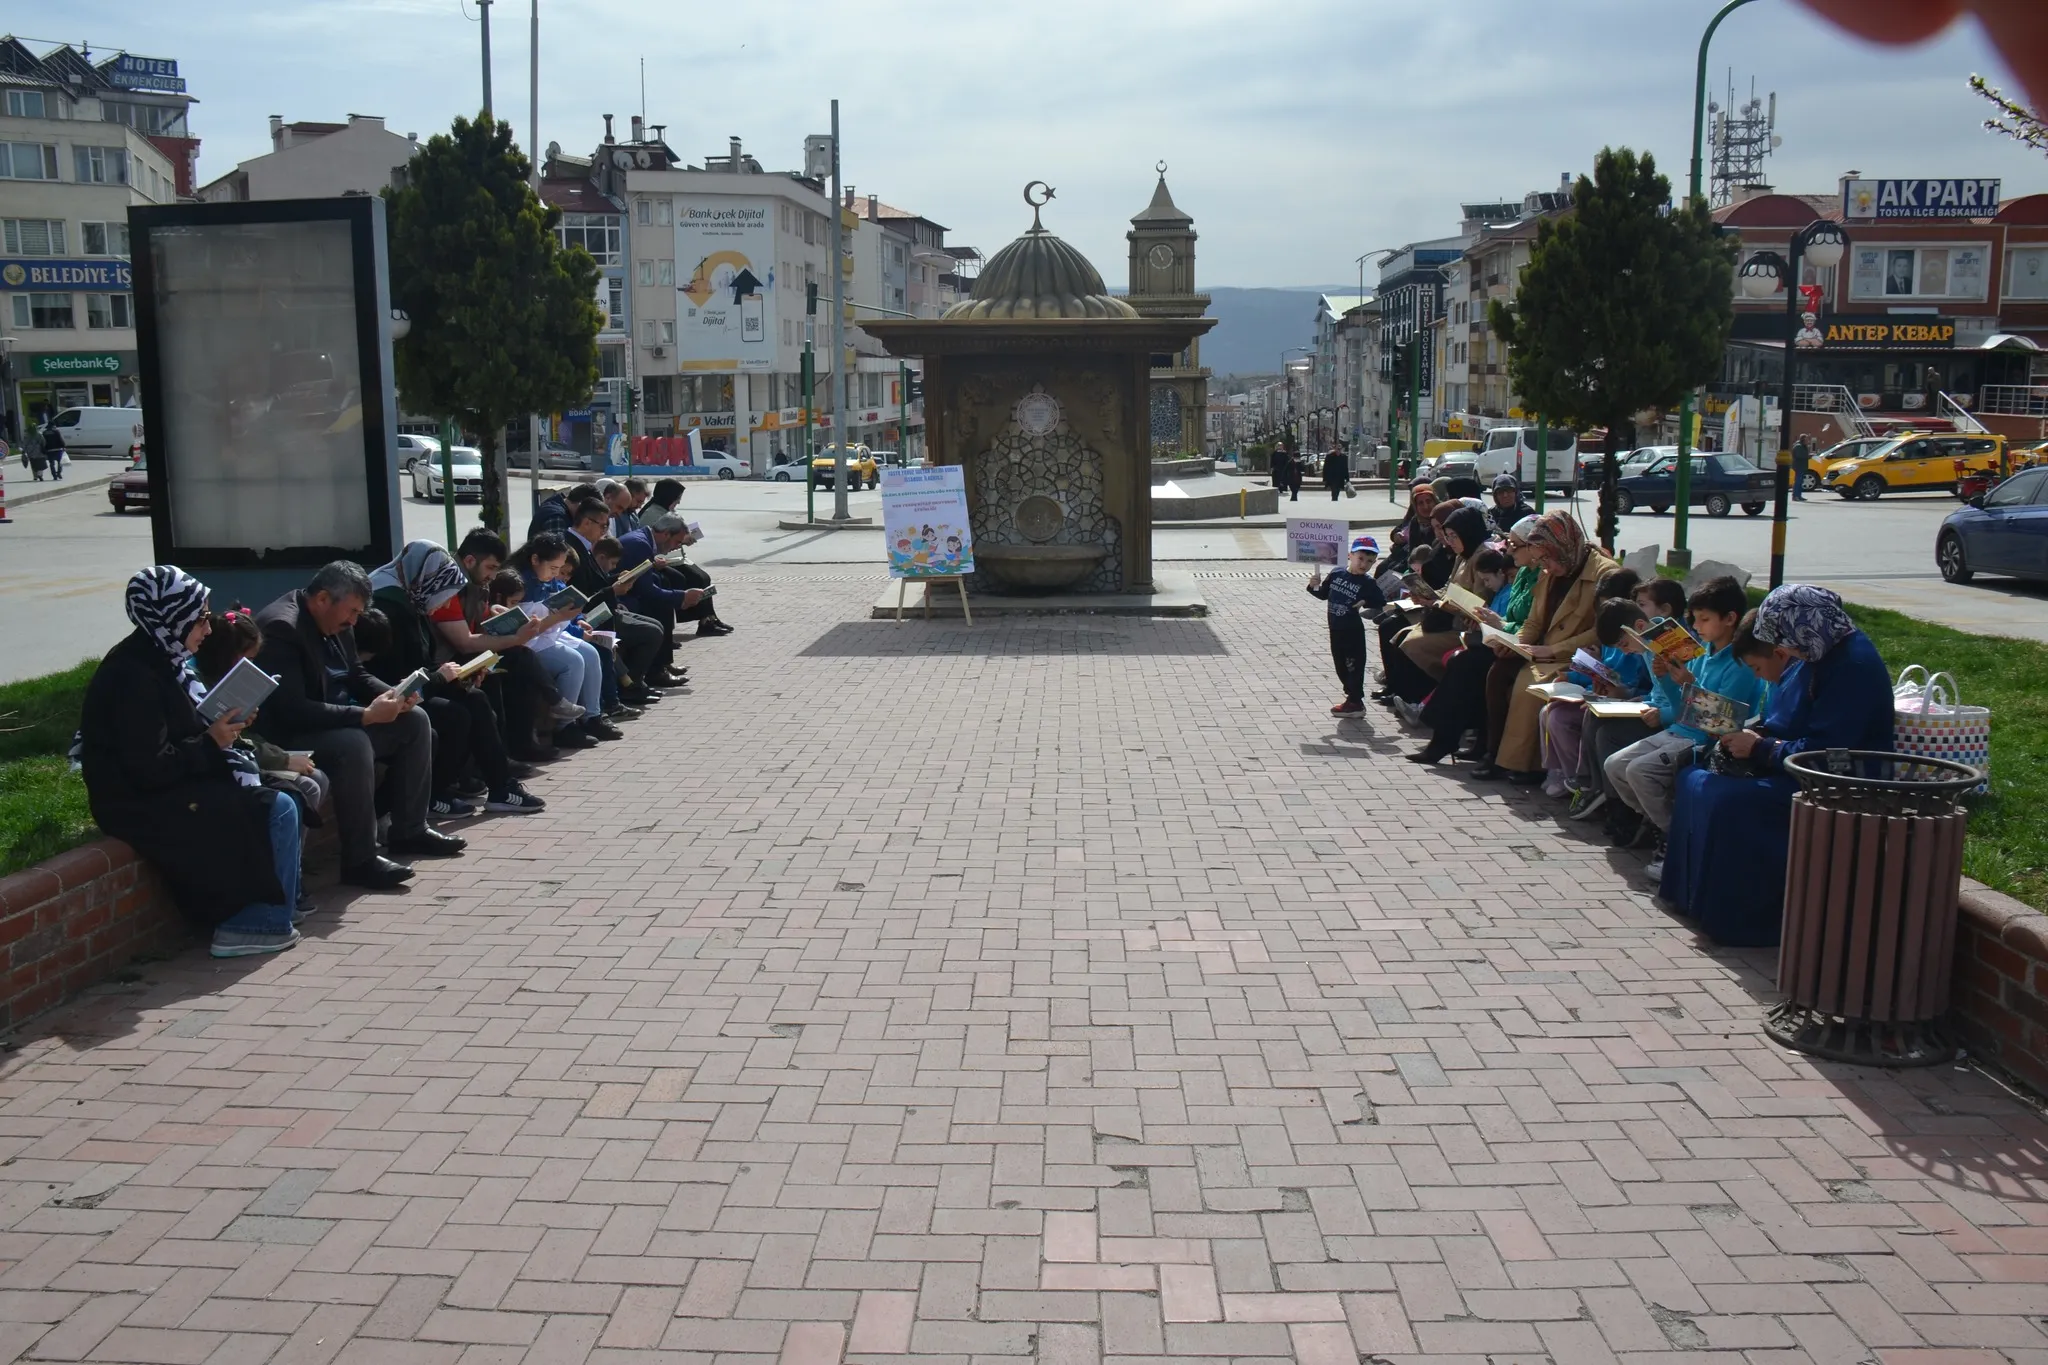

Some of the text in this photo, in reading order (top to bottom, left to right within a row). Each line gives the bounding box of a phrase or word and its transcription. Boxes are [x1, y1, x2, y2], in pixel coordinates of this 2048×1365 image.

[124, 57, 175, 75] HOTEL
[1880, 181, 1918, 206] AK
[738, 209, 764, 221] Dijital
[1879, 208, 1911, 217] TOSYA
[1937, 207, 1998, 218] BAŞKANLIĞI
[31, 263, 132, 289] BELEDİYE-İŞ
[702, 316, 726, 327] Dijital
[1826, 325, 1954, 341] ANTEP KEBAP
[43, 358, 103, 372] Şekerbank
[1300, 521, 1334, 530] OKUMAK
[1332, 577, 1361, 593] JEANS
